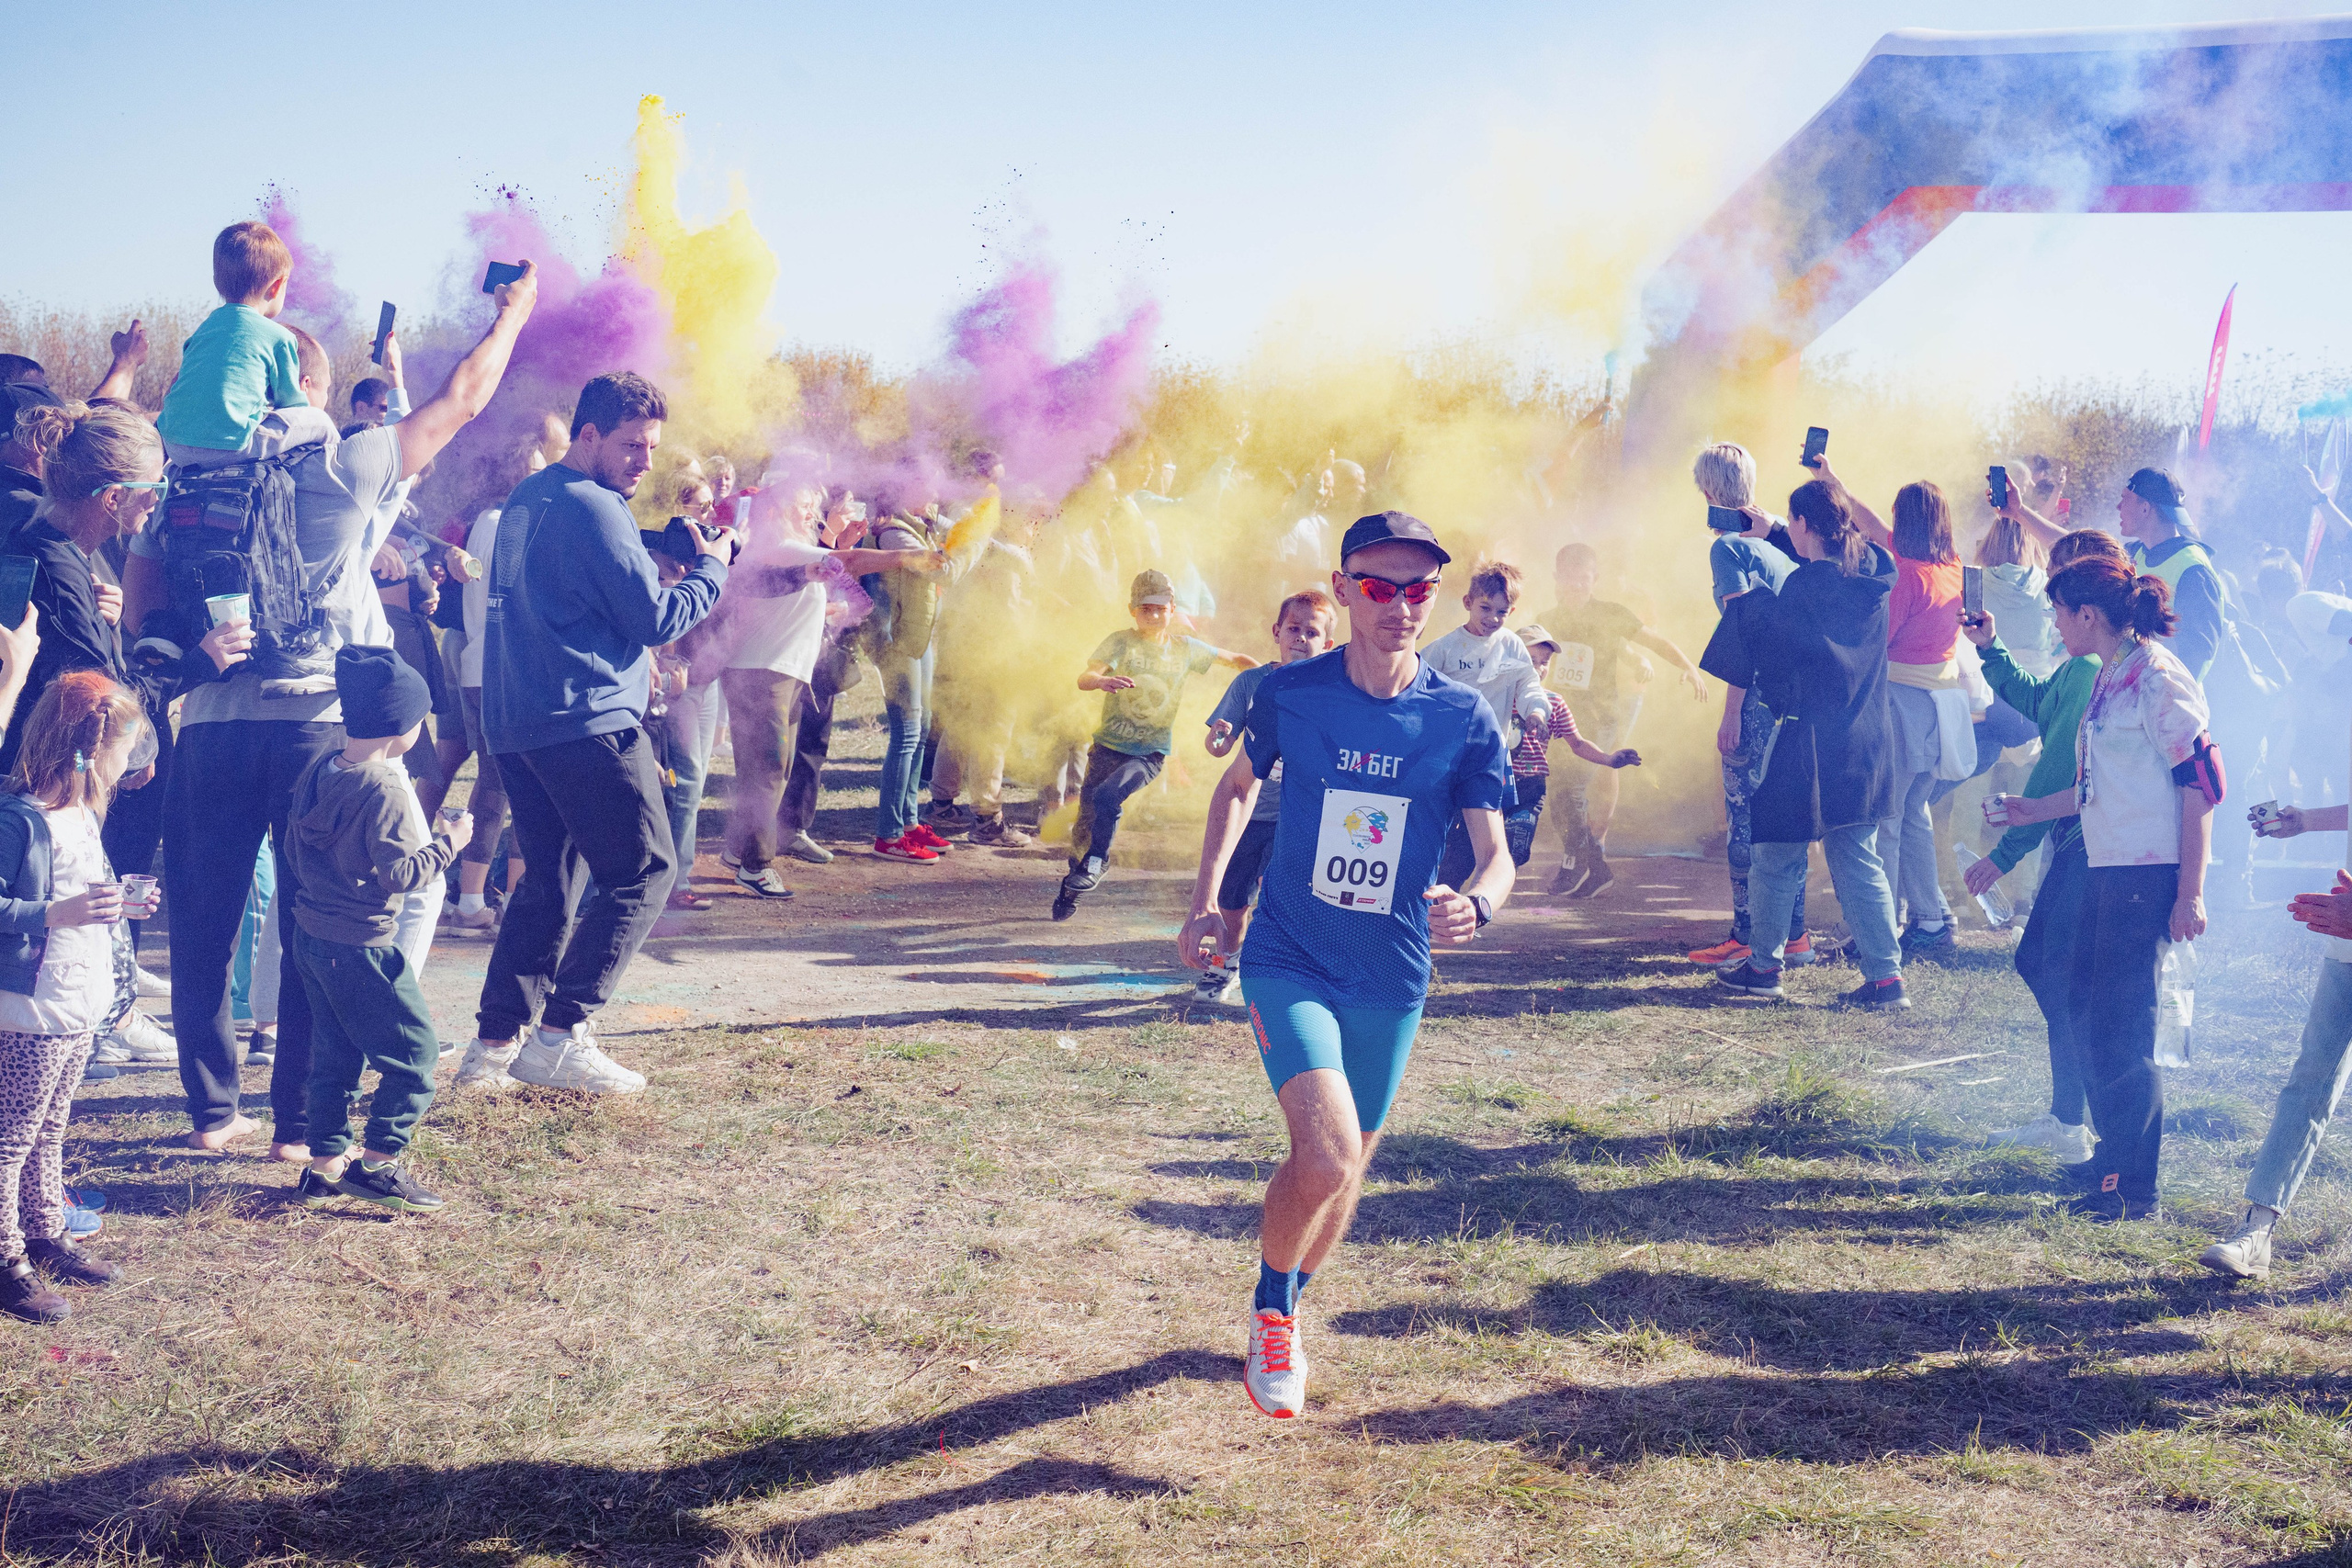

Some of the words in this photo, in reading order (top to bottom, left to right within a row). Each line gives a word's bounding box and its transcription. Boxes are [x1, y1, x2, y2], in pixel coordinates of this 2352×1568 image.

[1459, 659, 1474, 670] be
[2105, 660, 2119, 682] 2023
[1557, 667, 1584, 682] 305
[1327, 855, 1388, 888] 009
